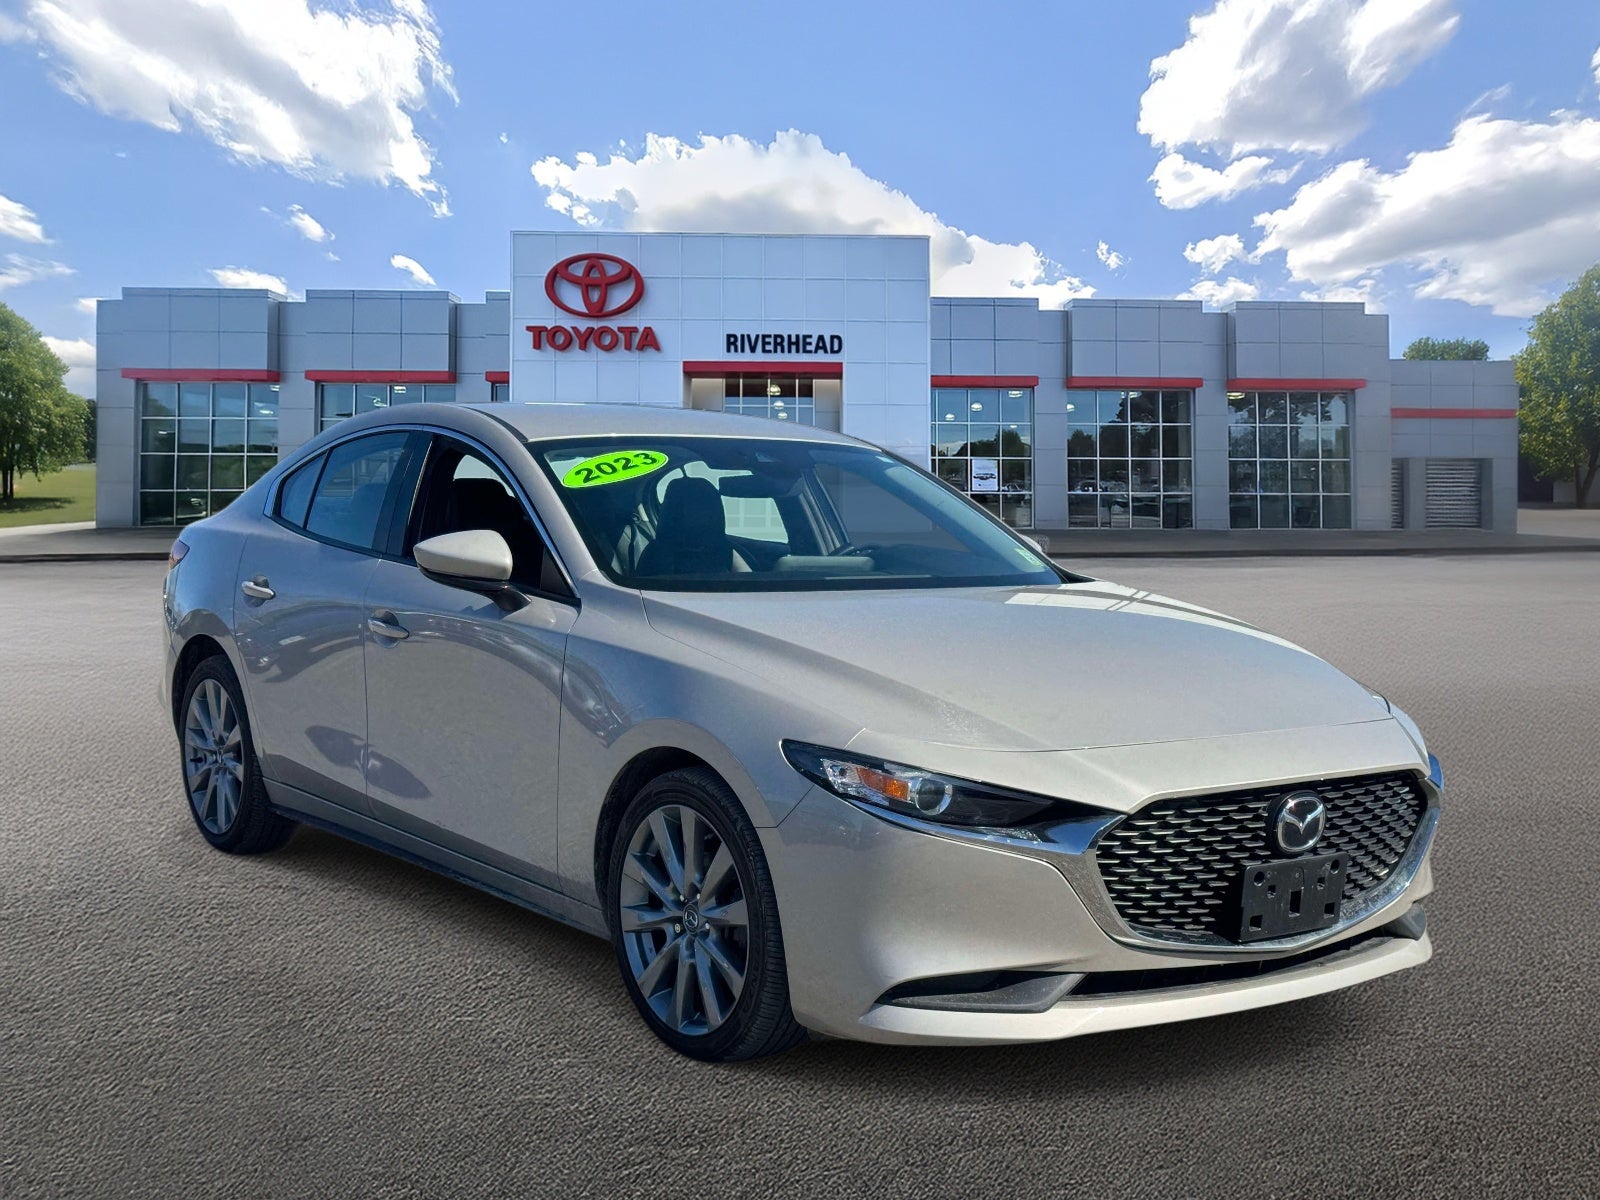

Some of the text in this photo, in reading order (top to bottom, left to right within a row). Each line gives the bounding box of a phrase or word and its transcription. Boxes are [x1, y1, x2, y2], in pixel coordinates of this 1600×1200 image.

[526, 325, 661, 352] TOYOTA
[725, 333, 843, 355] RIVERHEAD
[574, 452, 658, 484] 2023
